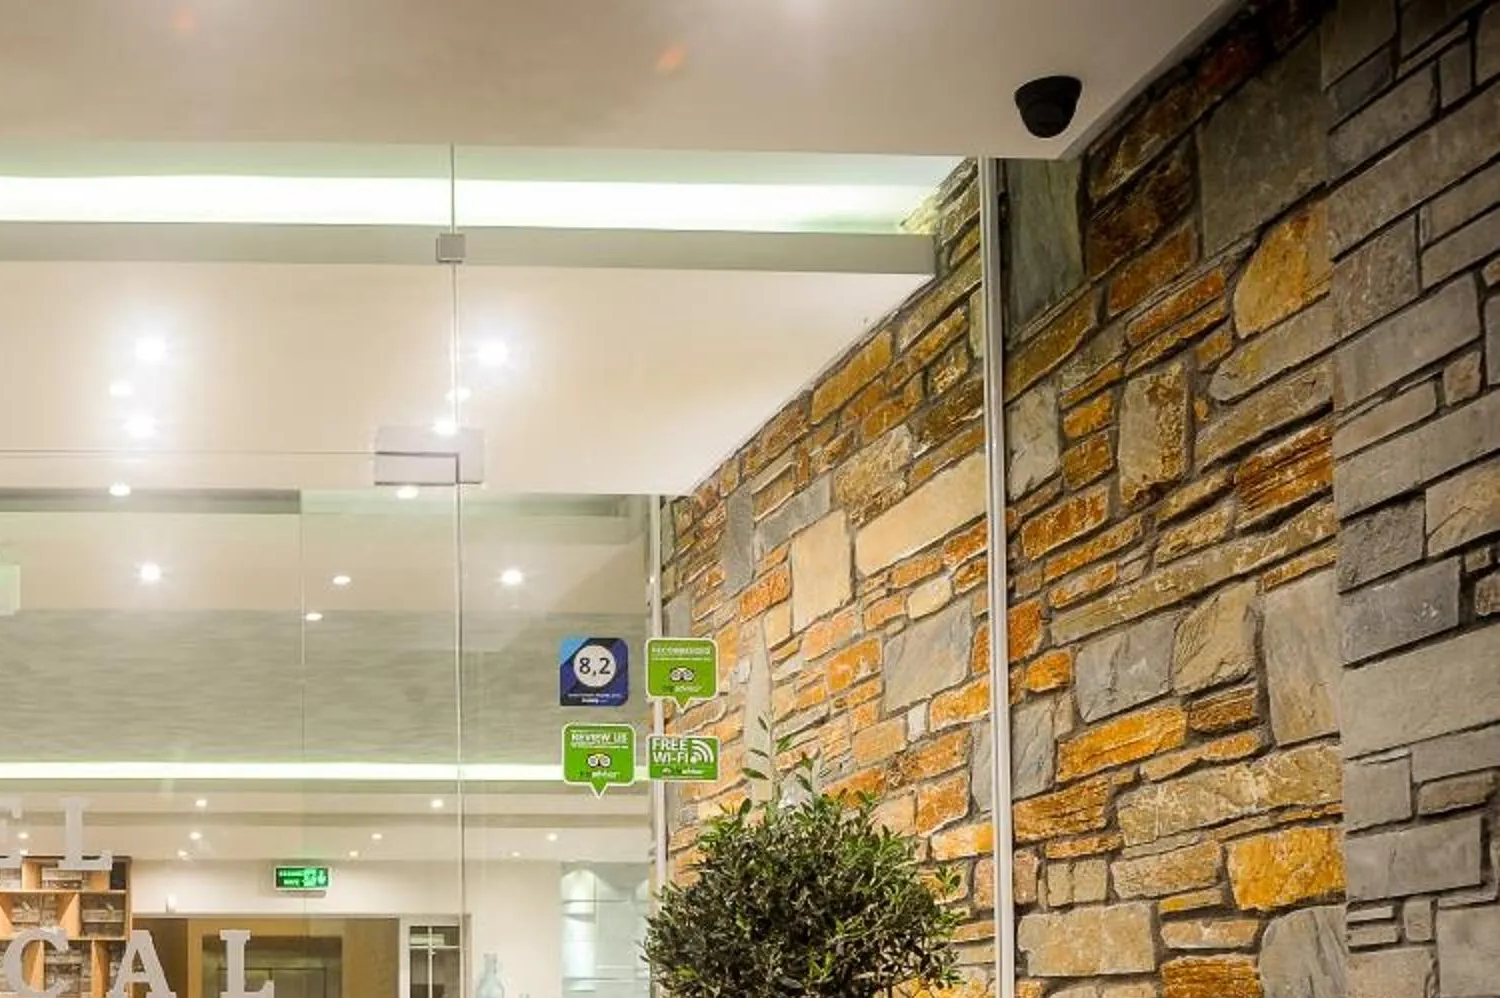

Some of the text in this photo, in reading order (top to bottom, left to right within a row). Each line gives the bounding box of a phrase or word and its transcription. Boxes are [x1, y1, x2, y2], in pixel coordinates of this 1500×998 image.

[579, 657, 611, 676] 8,2
[652, 737, 688, 750] FREE
[652, 751, 689, 764] WI-FI
